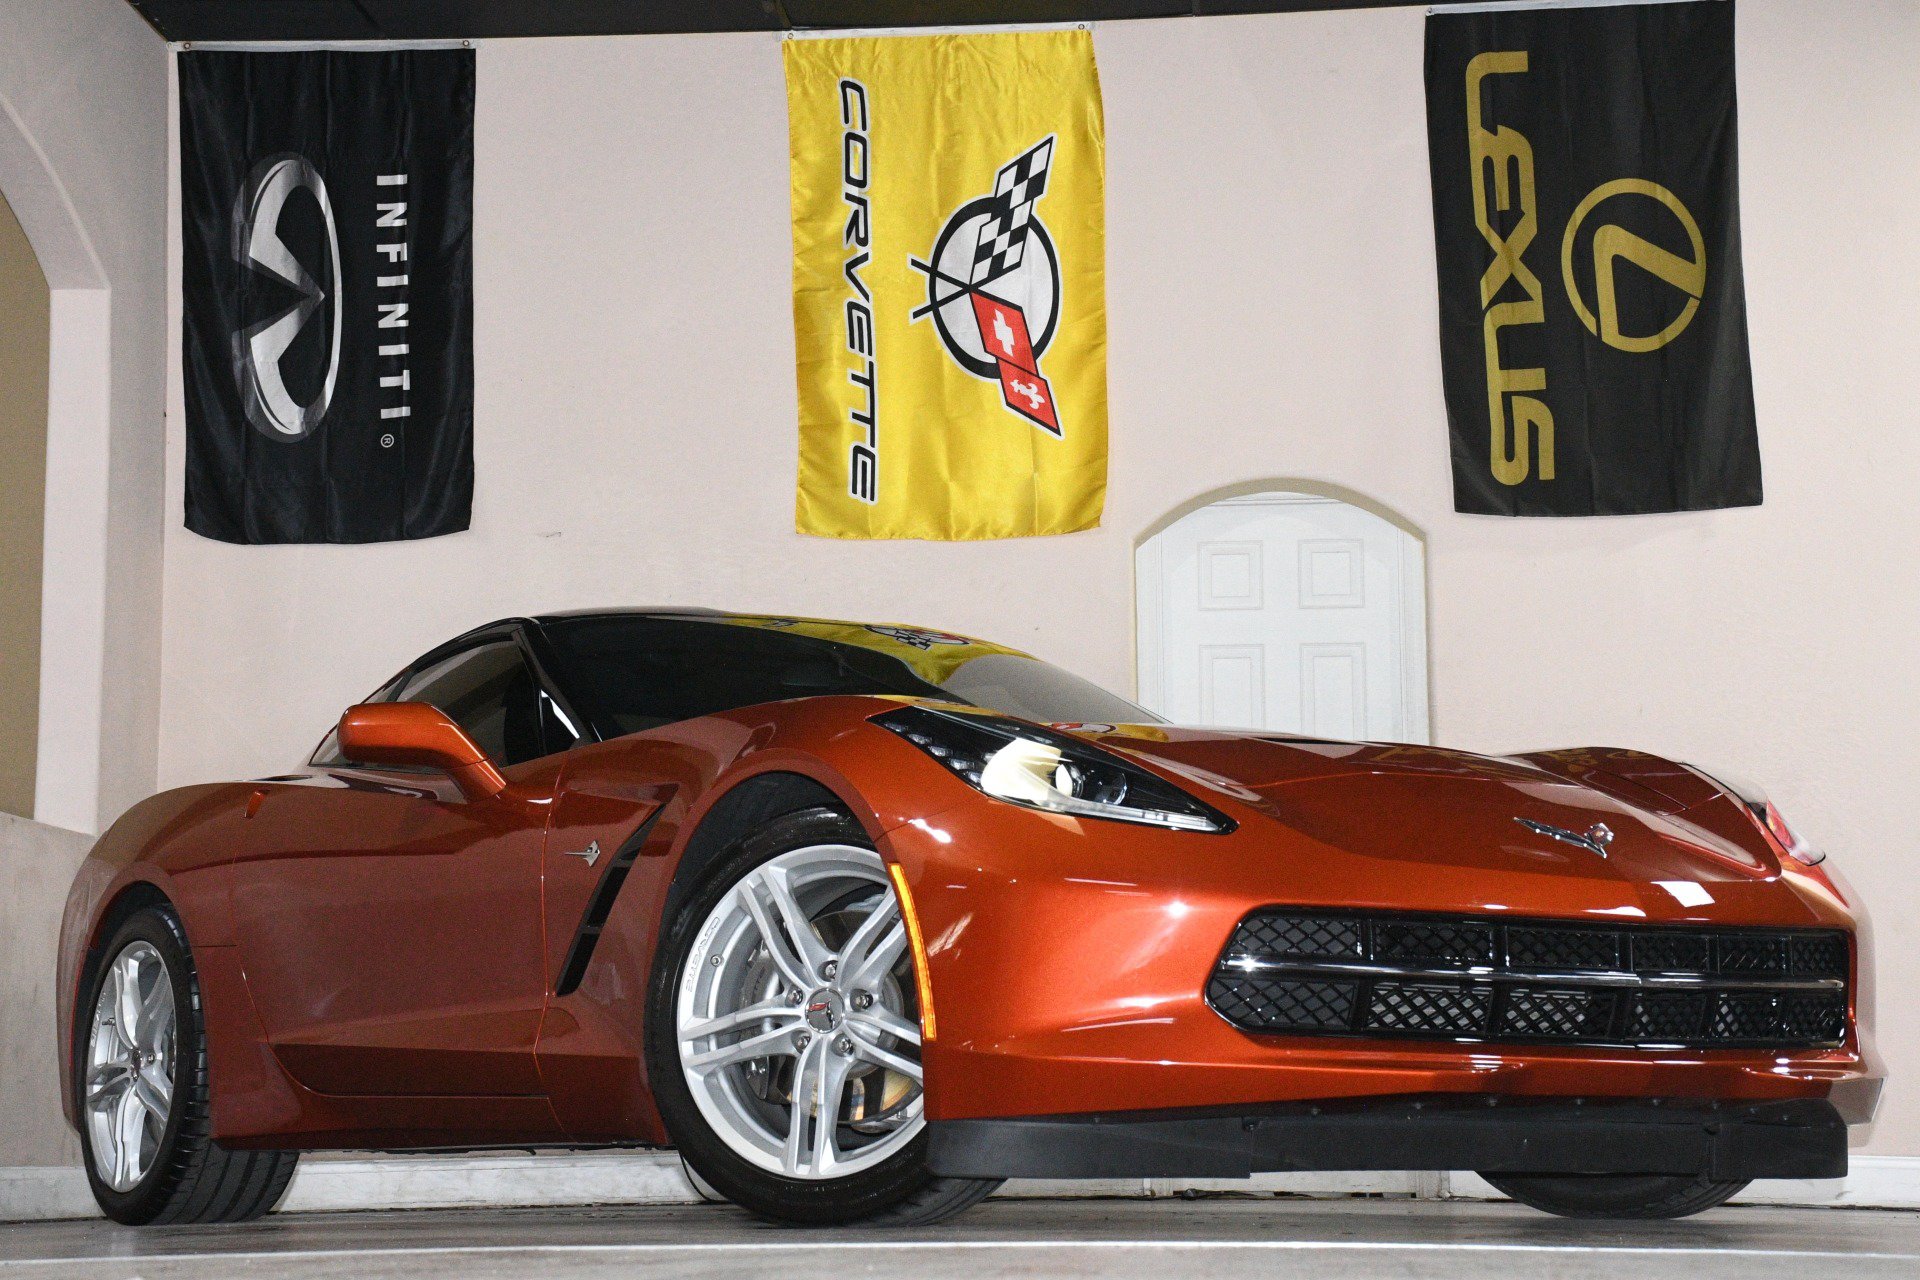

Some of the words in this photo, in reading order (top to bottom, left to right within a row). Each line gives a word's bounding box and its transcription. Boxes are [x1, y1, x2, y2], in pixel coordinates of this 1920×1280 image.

[376, 174, 411, 419] INFINITI
[838, 77, 878, 504] CORVETTE
[1465, 50, 1556, 486] LEXUS
